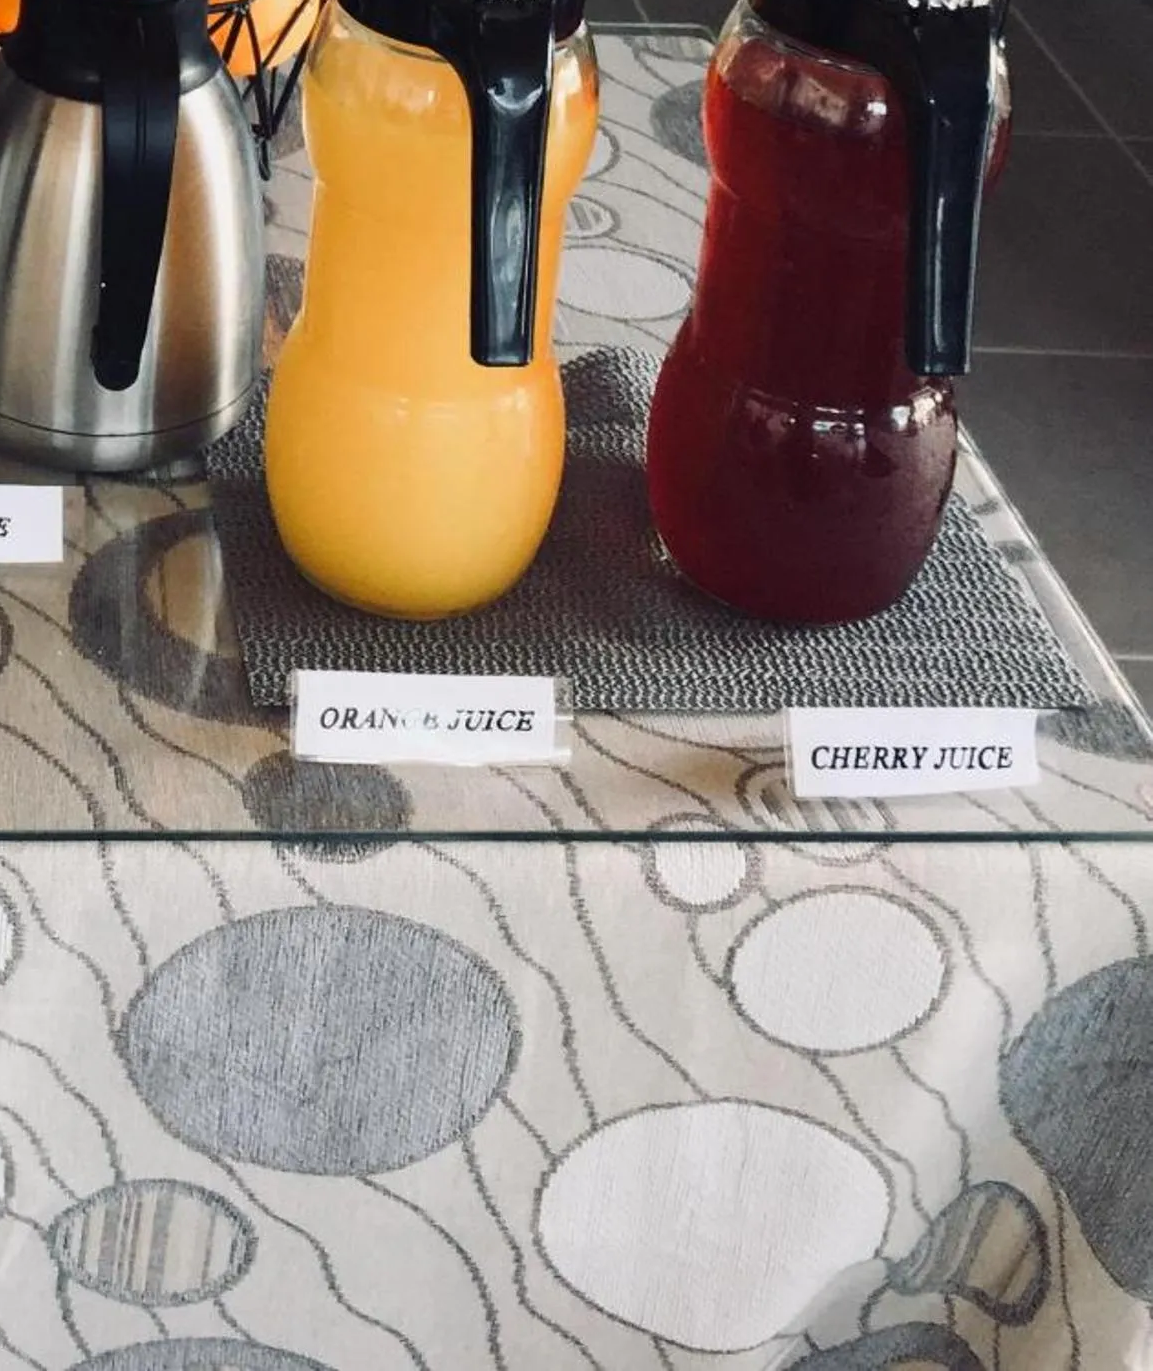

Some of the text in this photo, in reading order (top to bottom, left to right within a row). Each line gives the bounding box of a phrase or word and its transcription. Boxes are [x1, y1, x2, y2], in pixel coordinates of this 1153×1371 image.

[447, 709, 535, 731] JUICE
[811, 745, 1014, 770] CHERRY JUICE
